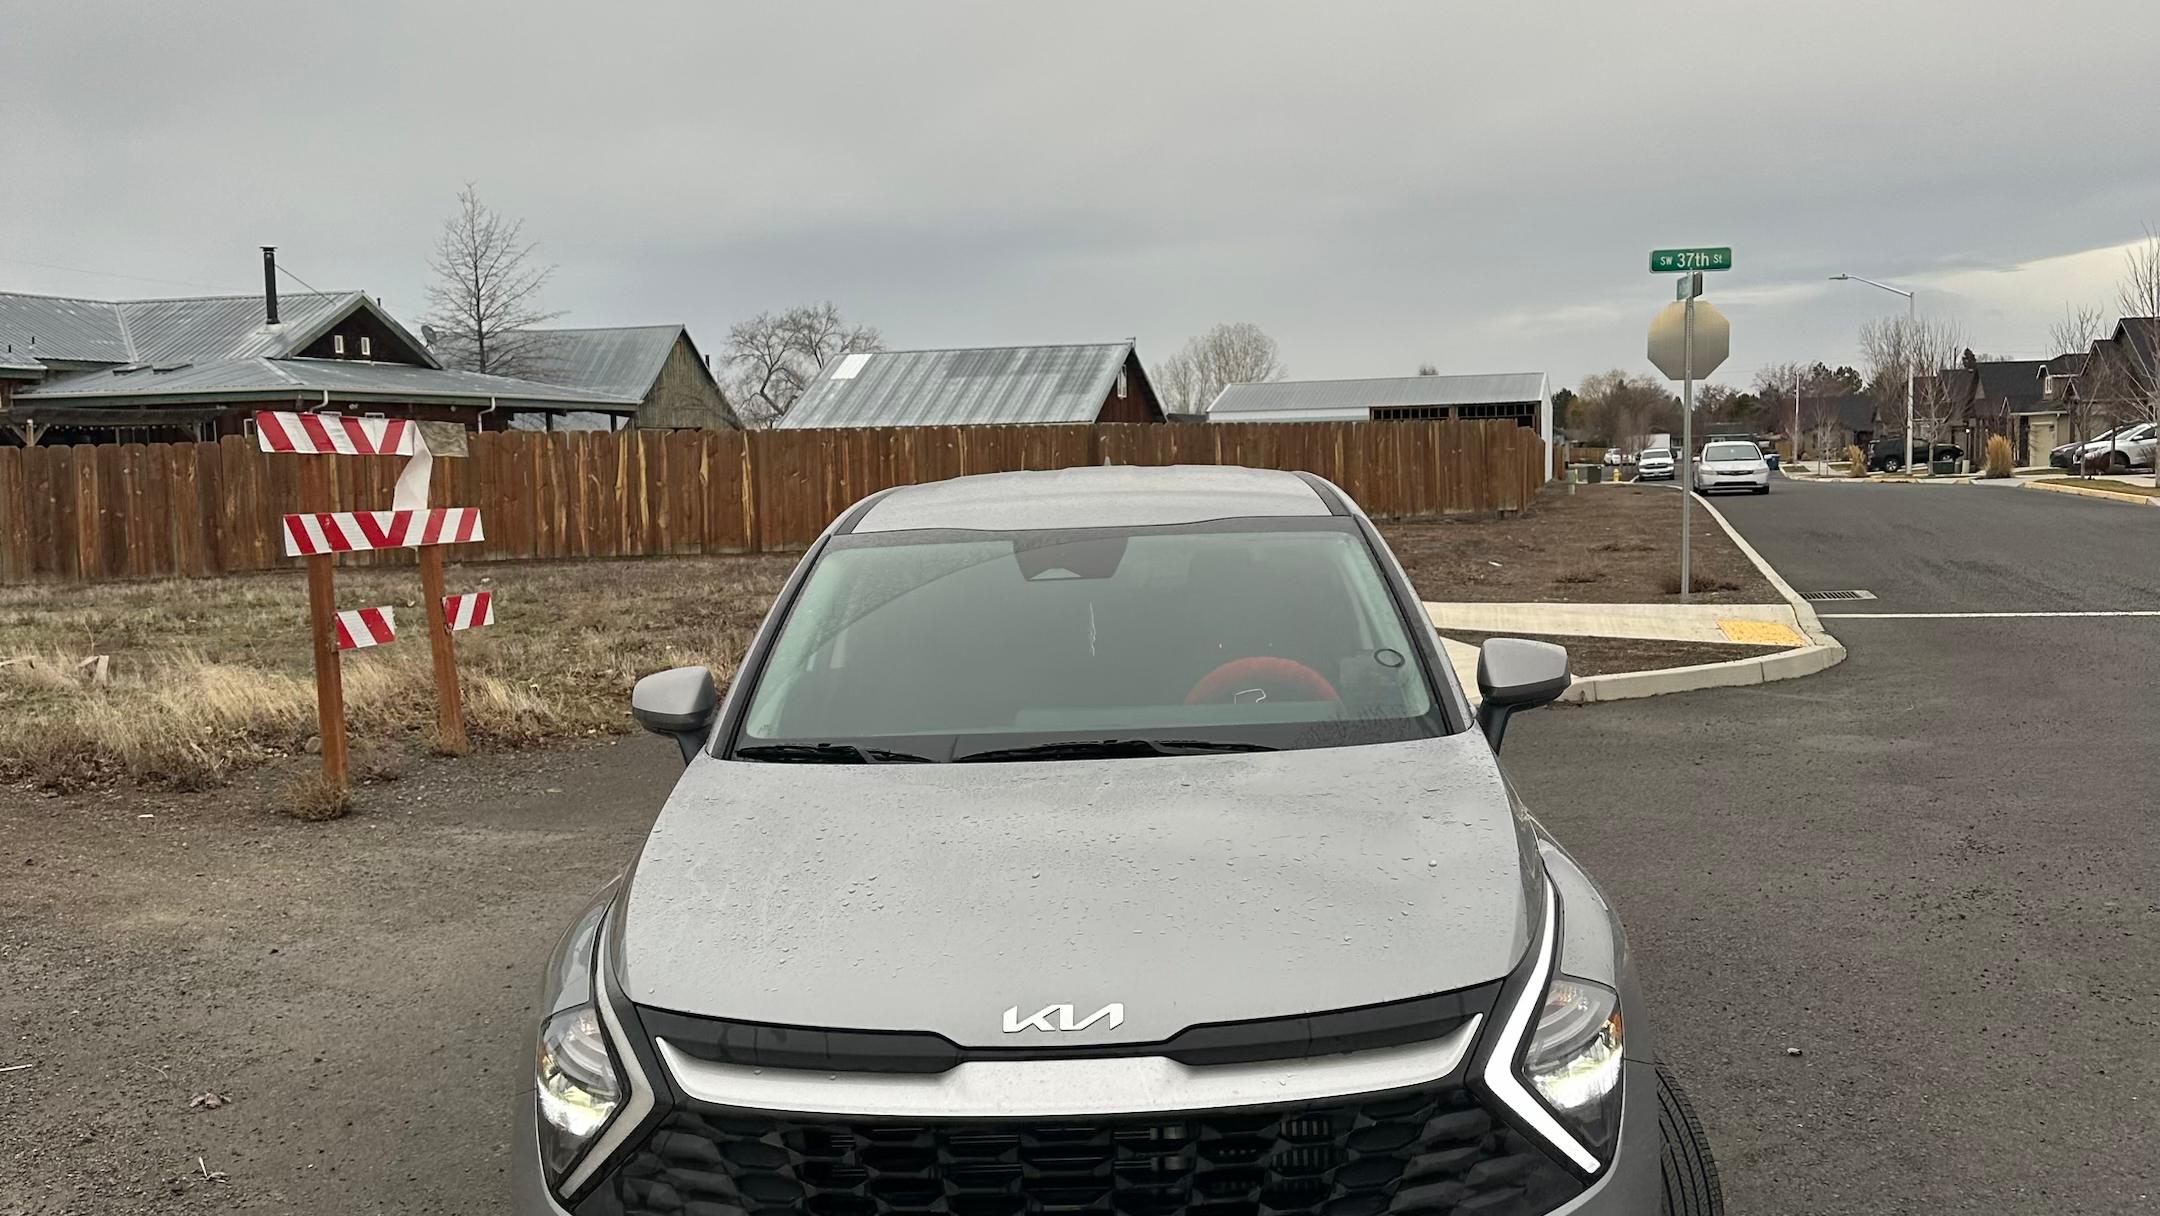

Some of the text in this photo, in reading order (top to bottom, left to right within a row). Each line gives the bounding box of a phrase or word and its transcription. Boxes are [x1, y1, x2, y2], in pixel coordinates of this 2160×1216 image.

[1660, 252, 1722, 268] SW 37th St
[1002, 1002, 1124, 1033] KIA
